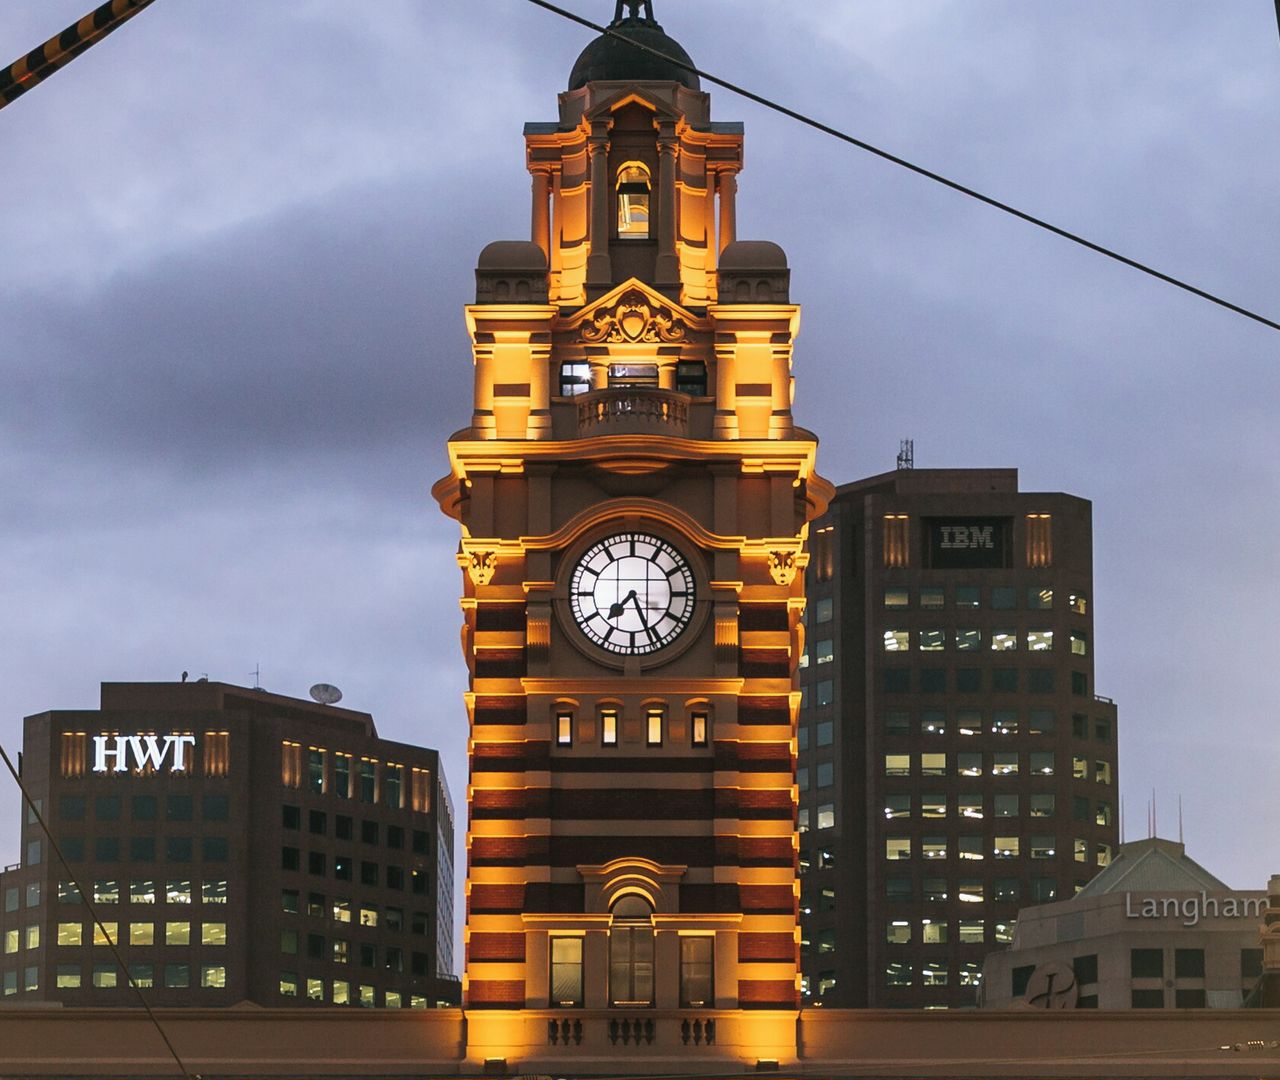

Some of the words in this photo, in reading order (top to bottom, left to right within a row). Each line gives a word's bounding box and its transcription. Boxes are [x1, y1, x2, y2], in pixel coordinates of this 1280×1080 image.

[940, 526, 994, 549] IBM
[92, 735, 195, 773] HWT
[1125, 892, 1271, 927] Langham
